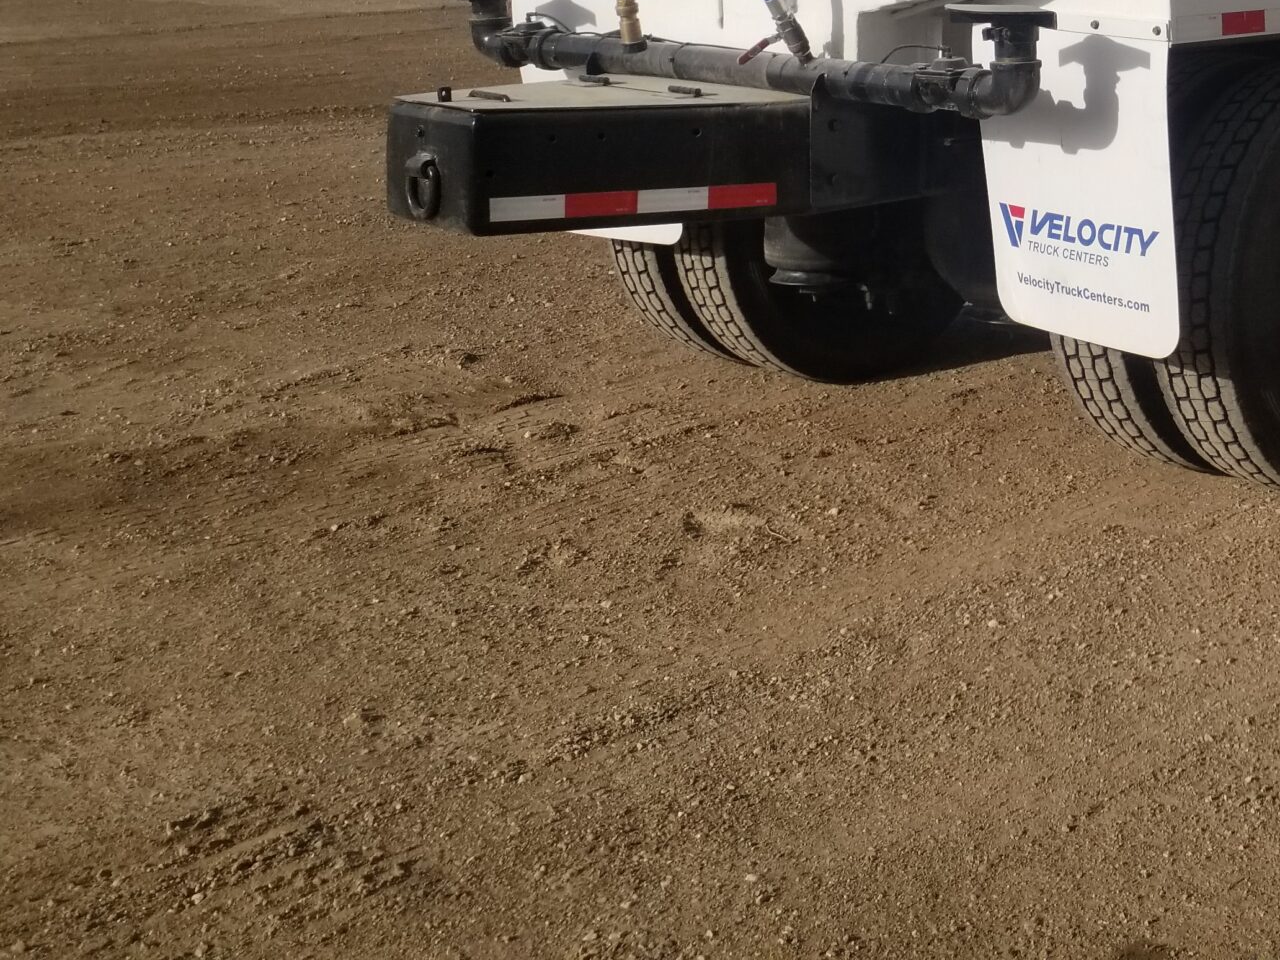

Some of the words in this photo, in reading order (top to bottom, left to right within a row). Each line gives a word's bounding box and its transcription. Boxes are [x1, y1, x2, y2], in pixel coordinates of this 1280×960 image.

[1027, 240, 1059, 258] TRUCK
[1062, 248, 1109, 268] CENTERS
[1030, 209, 1160, 257] VELOCITY
[1017, 271, 1150, 313] VelocityTruckCenters.com
